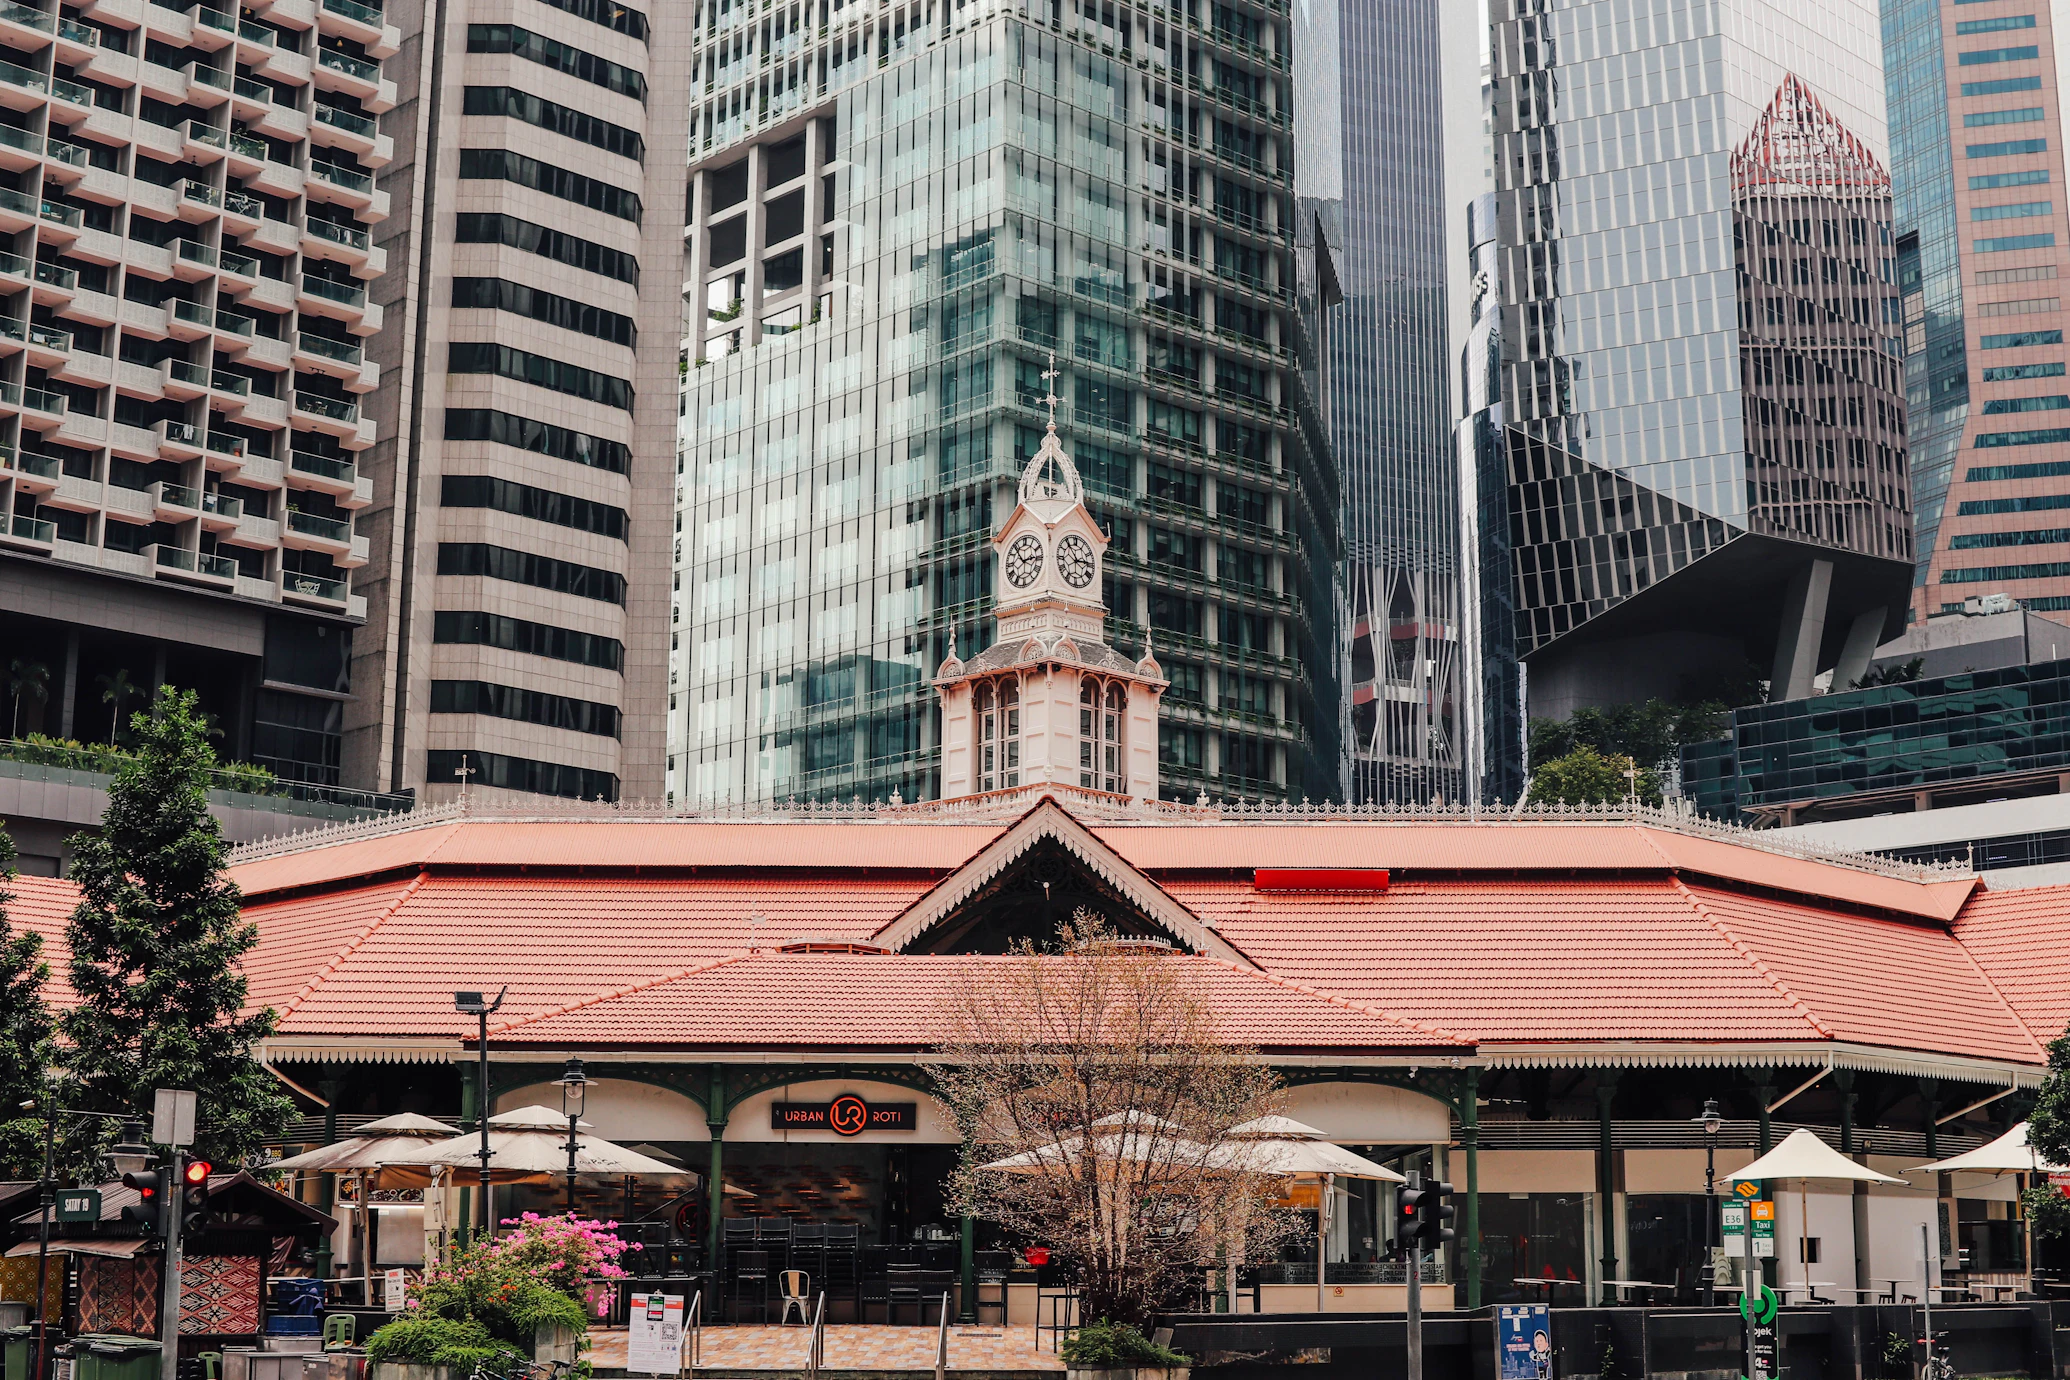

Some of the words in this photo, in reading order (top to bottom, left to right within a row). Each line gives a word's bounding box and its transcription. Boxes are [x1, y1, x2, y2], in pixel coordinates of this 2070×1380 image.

[785, 1111, 824, 1122] URBAN
[872, 1111, 901, 1122] ROTI
[65, 1198, 81, 1212] SATAY
[82, 1198, 89, 1212] 19
[1725, 1215, 1741, 1224] E36
[1755, 1221, 1770, 1229] Taxi
[1754, 1241, 1760, 1253] 1
[1413, 1271, 1418, 1280] 2
